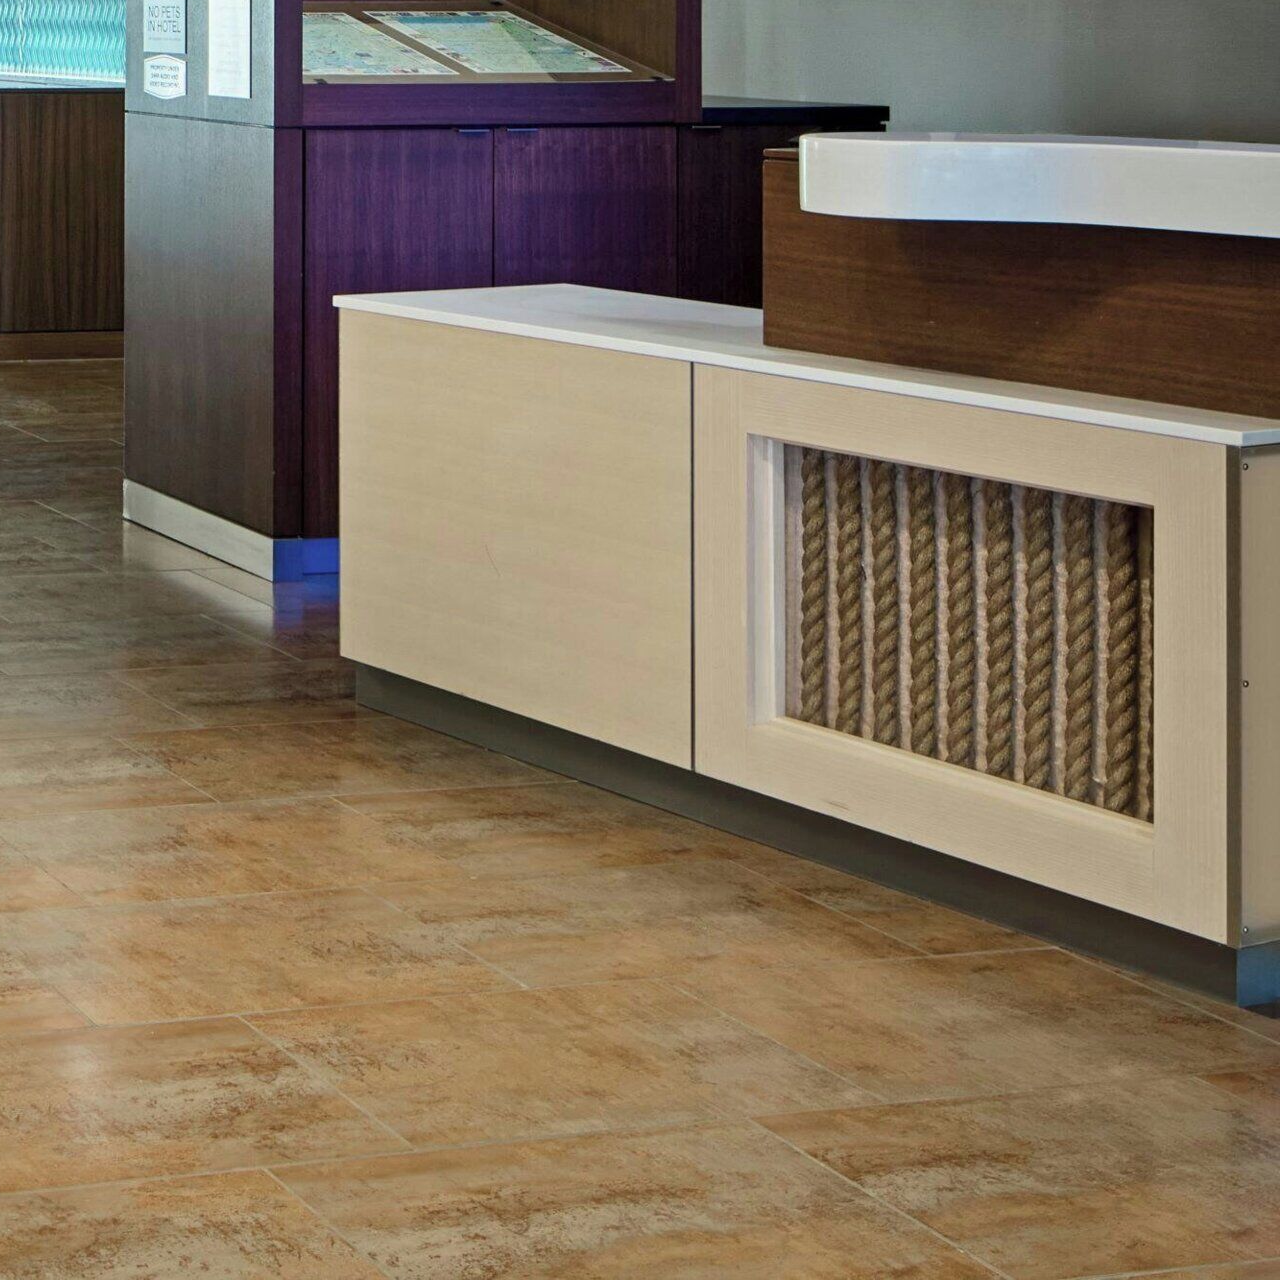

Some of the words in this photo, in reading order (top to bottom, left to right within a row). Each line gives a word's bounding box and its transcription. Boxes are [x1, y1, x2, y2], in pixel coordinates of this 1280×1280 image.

[148, 5, 159, 18] NO
[161, 5, 181, 19] PETS
[147, 20, 155, 31] IN
[157, 20, 181, 33] HOTEL
